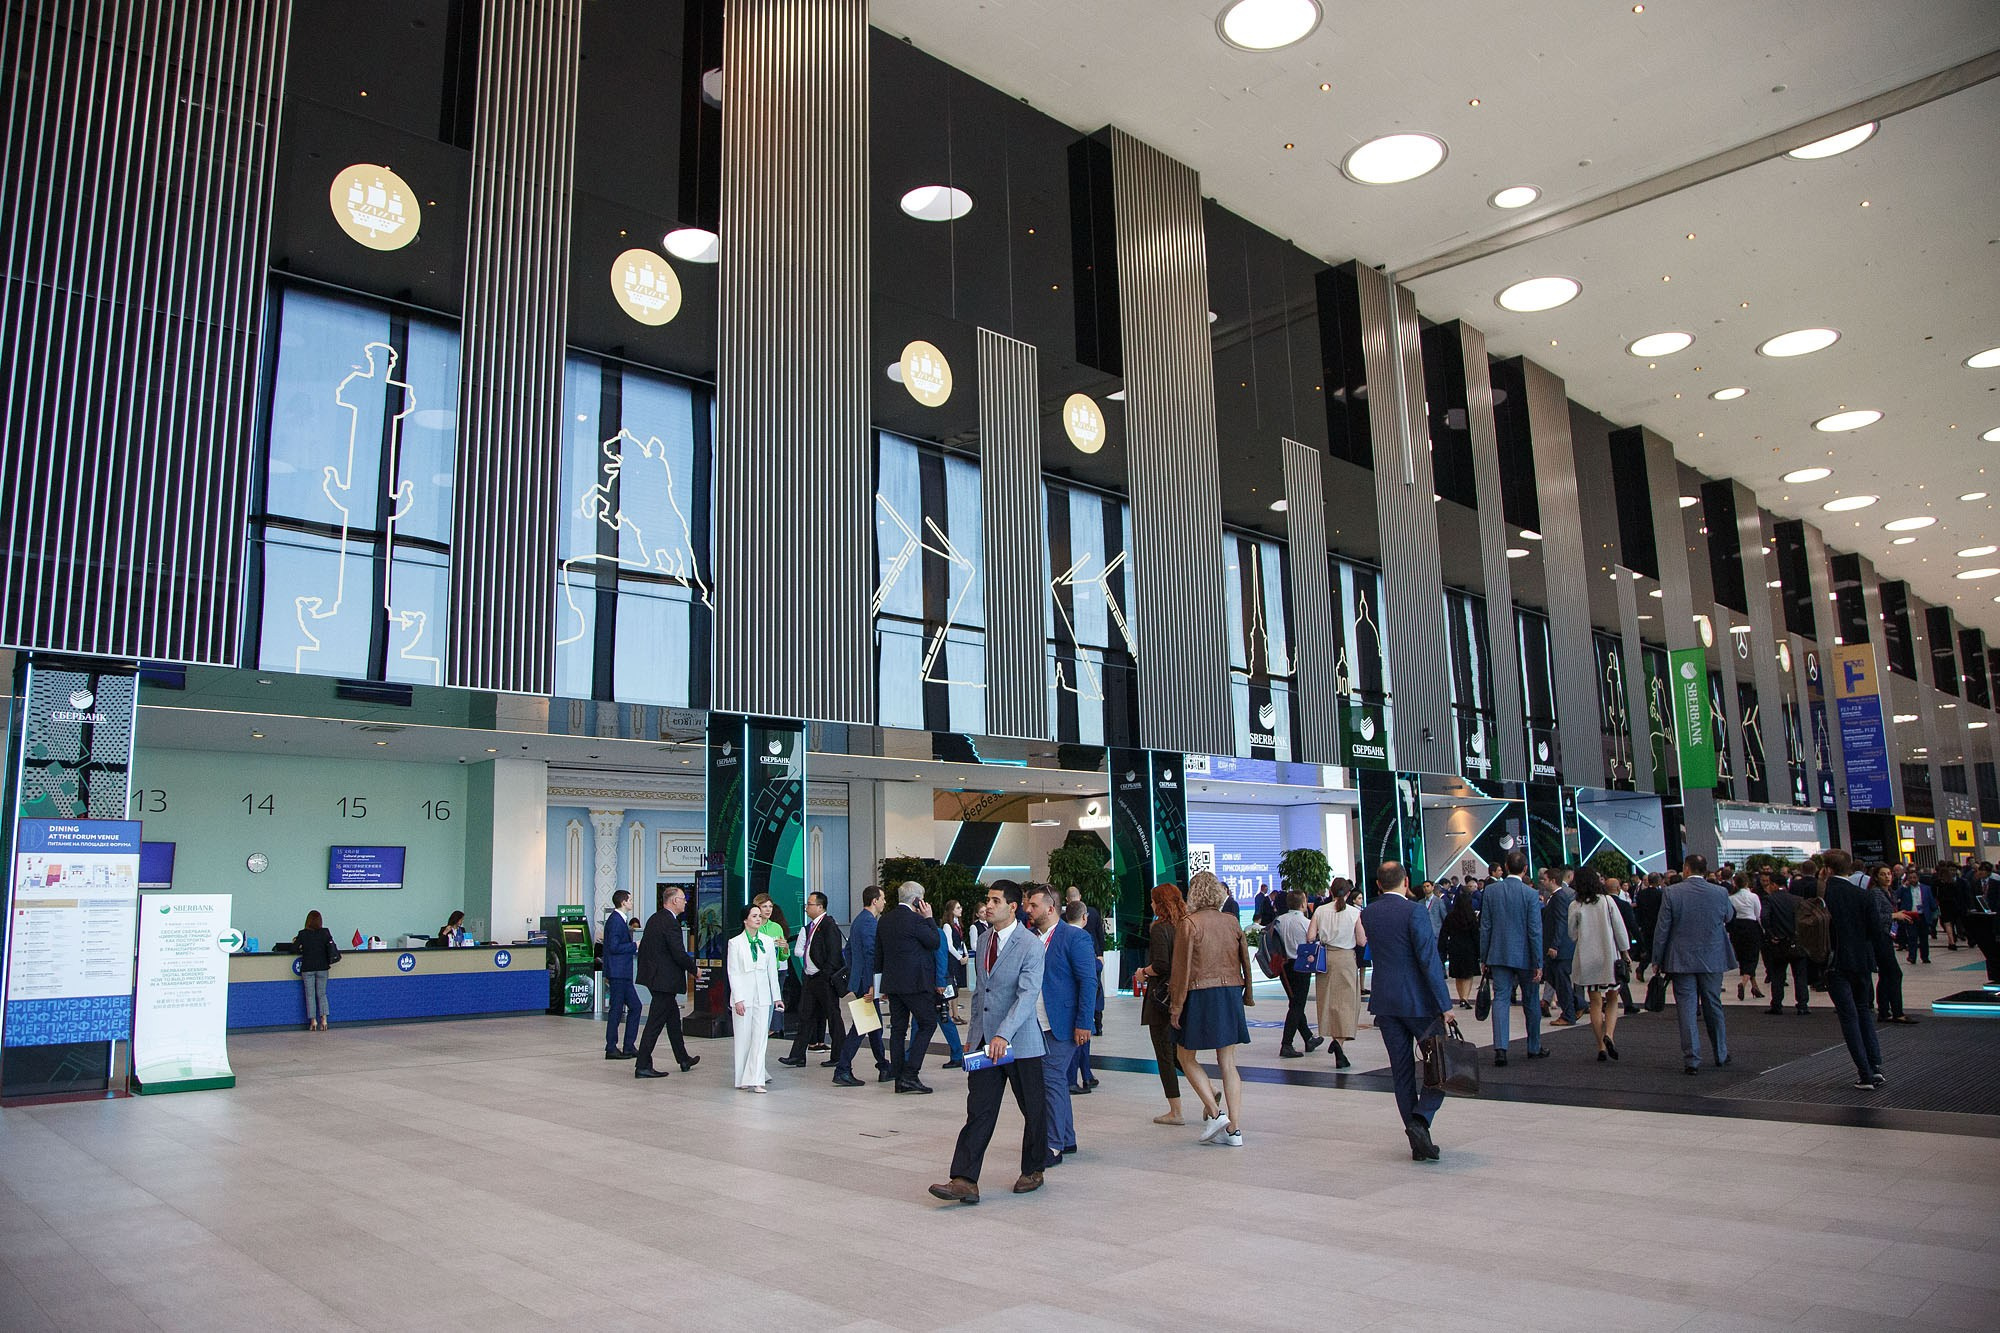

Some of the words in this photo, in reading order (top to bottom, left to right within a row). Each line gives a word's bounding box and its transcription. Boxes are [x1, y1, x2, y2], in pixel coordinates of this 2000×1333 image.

[1844, 660, 1864, 693] F
[52, 710, 107, 722] СБЕРБАНК
[1686, 682, 1702, 745] SBERBANK
[1250, 732, 1288, 746] SBERBANK
[1352, 744, 1385, 756] СБЕРБАНК
[716, 757, 737, 766] СБЕРБАНК
[760, 756, 790, 764] СБЕРБАНК
[1466, 756, 1491, 767] SBERBANK
[1534, 764, 1556, 774] СБЕРБАНК
[132, 788, 168, 812] 13
[242, 794, 275, 816] 14
[336, 796, 367, 819] 15
[421, 800, 450, 820] 16
[1749, 818, 1760, 830] Банк
[1780, 820, 1791, 831] Банк
[1136, 824, 1150, 858] SBERLEGAL
[7, 1001, 42, 1013] SPIEF
[47, 999, 91, 1011] ПМЭФ
[92, 997, 126, 1009] SPIEF
[6, 1012, 50, 1024] ПМЭФ
[51, 1010, 87, 1021] SPIEF
[6, 1024, 40, 1036] SPIEF
[46, 1021, 90, 1032] ПМЭФ
[91, 1019, 126, 1031] SPIEF
